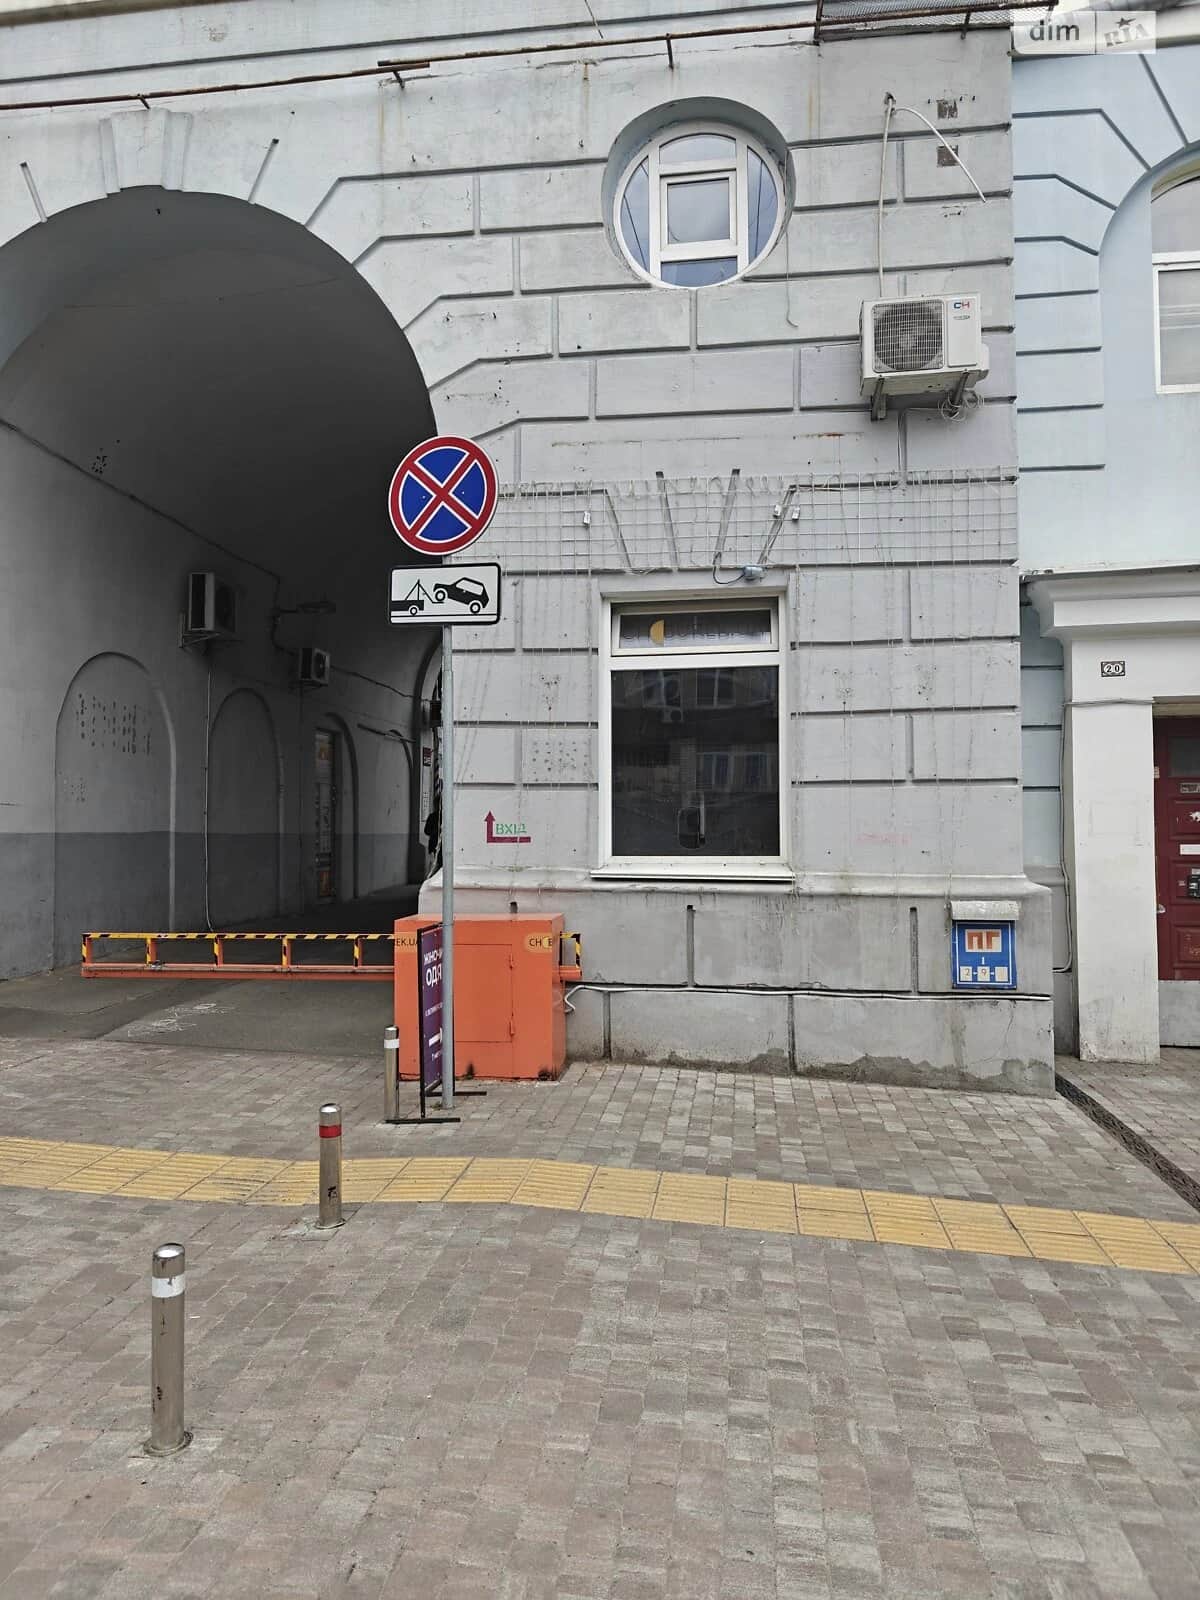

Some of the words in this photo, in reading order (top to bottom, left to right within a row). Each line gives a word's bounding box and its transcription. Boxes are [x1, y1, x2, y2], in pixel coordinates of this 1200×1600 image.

[1106, 664, 1120, 673] 20
[496, 823, 527, 835] ВХІД
[967, 931, 1000, 950] ПГ
[425, 963, 442, 987] ОДЯ
